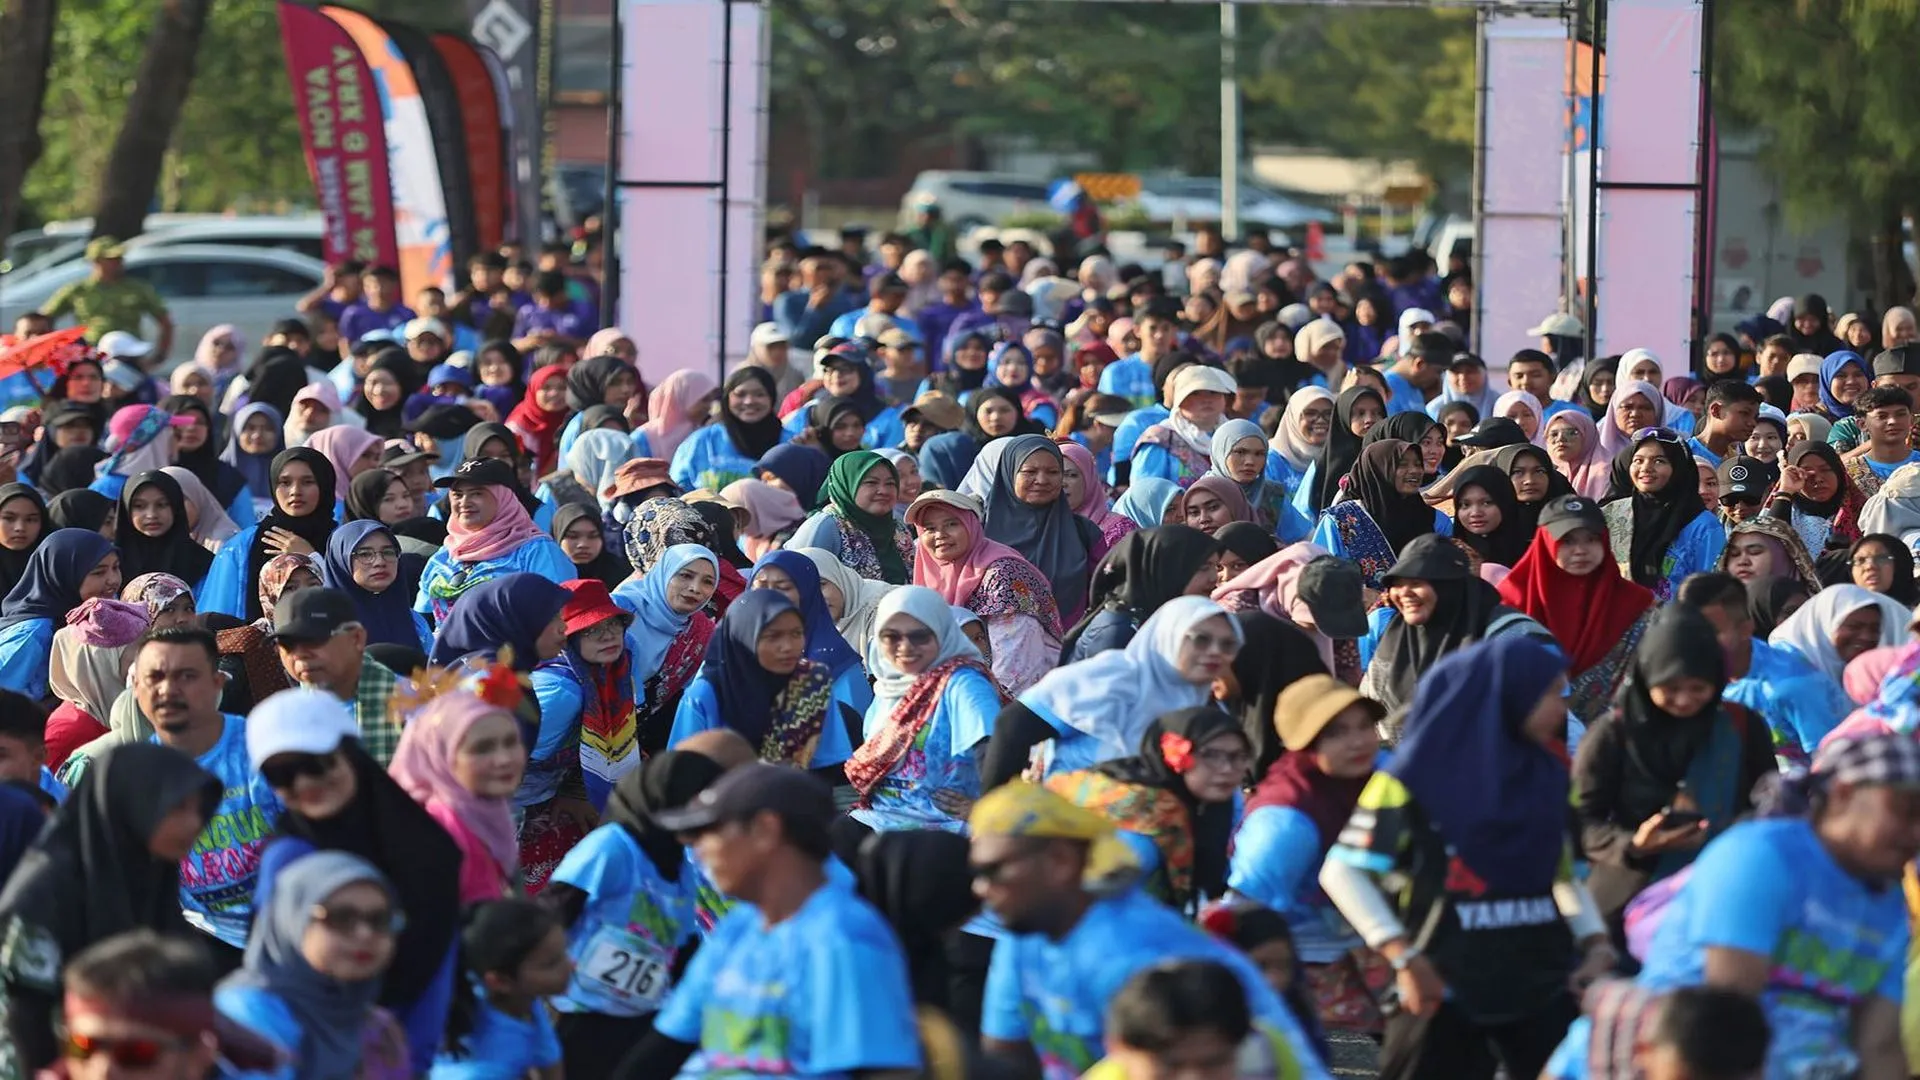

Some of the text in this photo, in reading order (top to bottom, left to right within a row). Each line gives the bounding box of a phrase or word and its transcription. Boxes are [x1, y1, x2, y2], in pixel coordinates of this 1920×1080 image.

[306, 66, 334, 148] NOVA
[332, 45, 364, 122] XRAY
[345, 161, 374, 220] JAM
[354, 228, 378, 261] 24
[600, 950, 658, 994] 216
